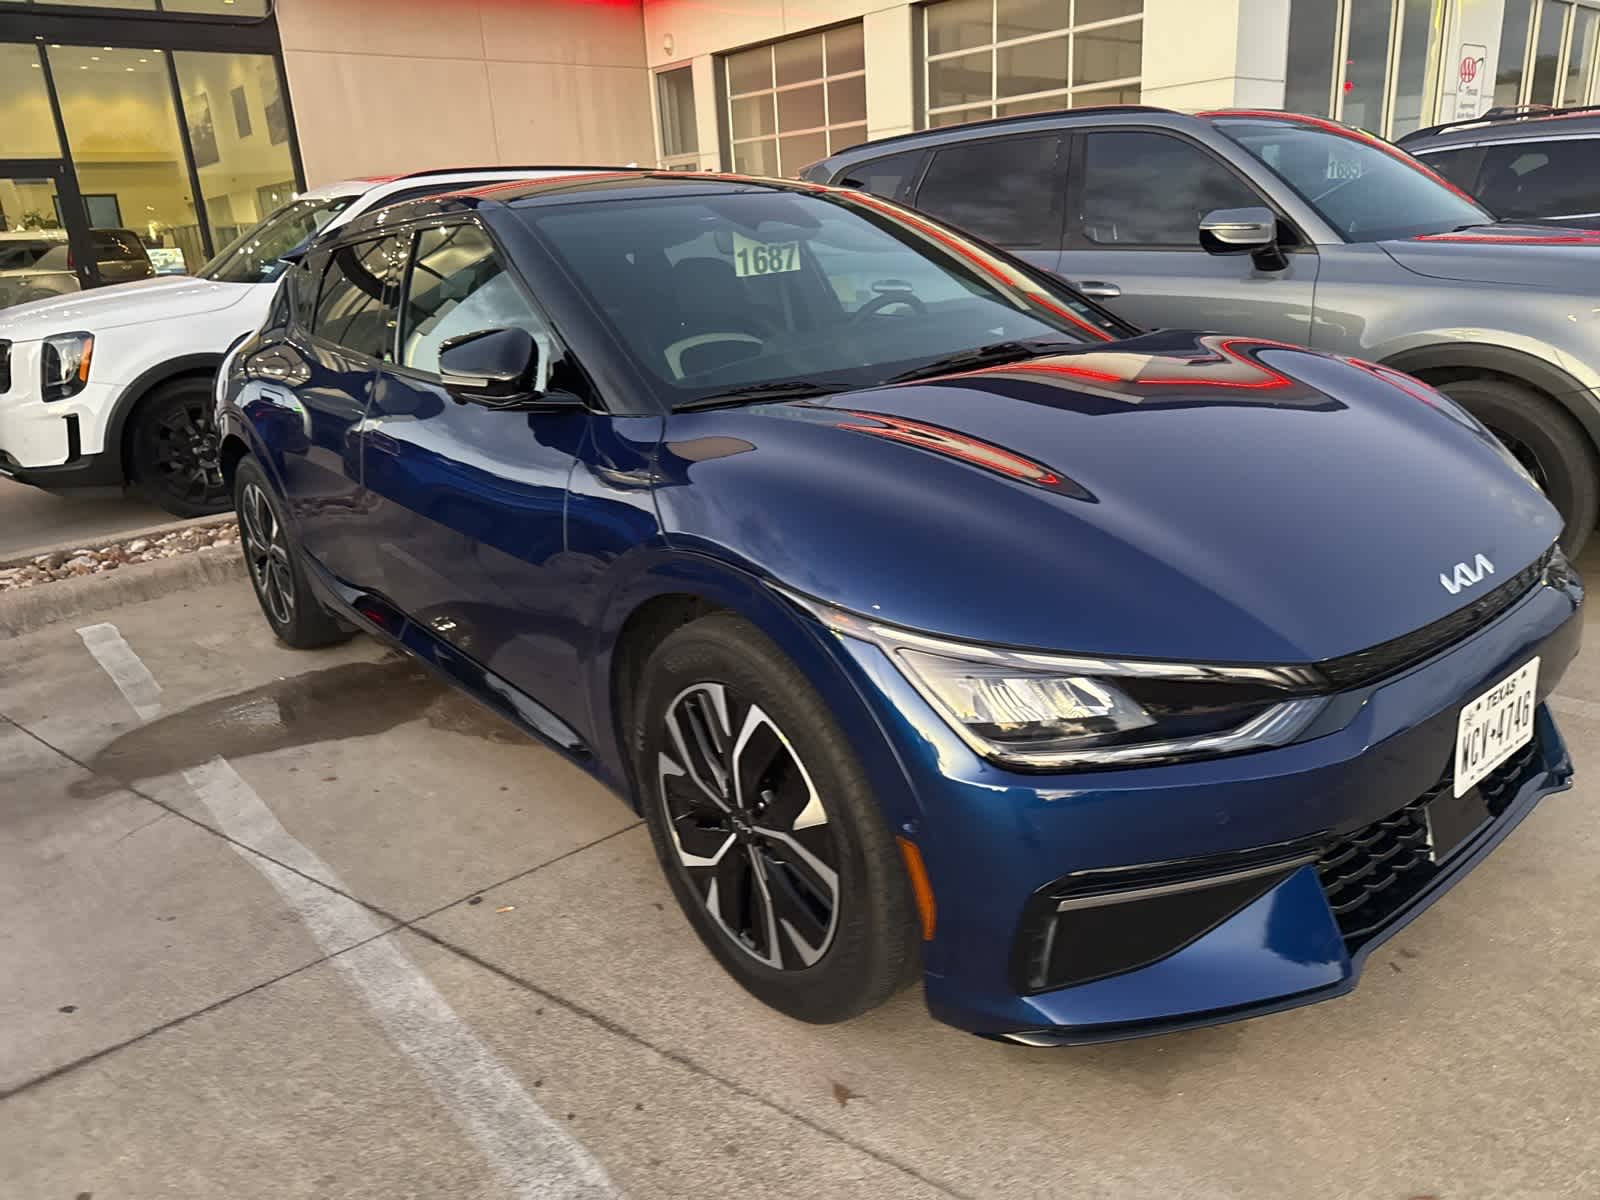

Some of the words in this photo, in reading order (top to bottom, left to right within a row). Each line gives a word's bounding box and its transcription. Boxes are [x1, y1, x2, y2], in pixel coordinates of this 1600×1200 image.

[737, 244, 796, 275] 1687
[1440, 553, 1495, 594] KIA
[1486, 678, 1517, 711] TEXAS
